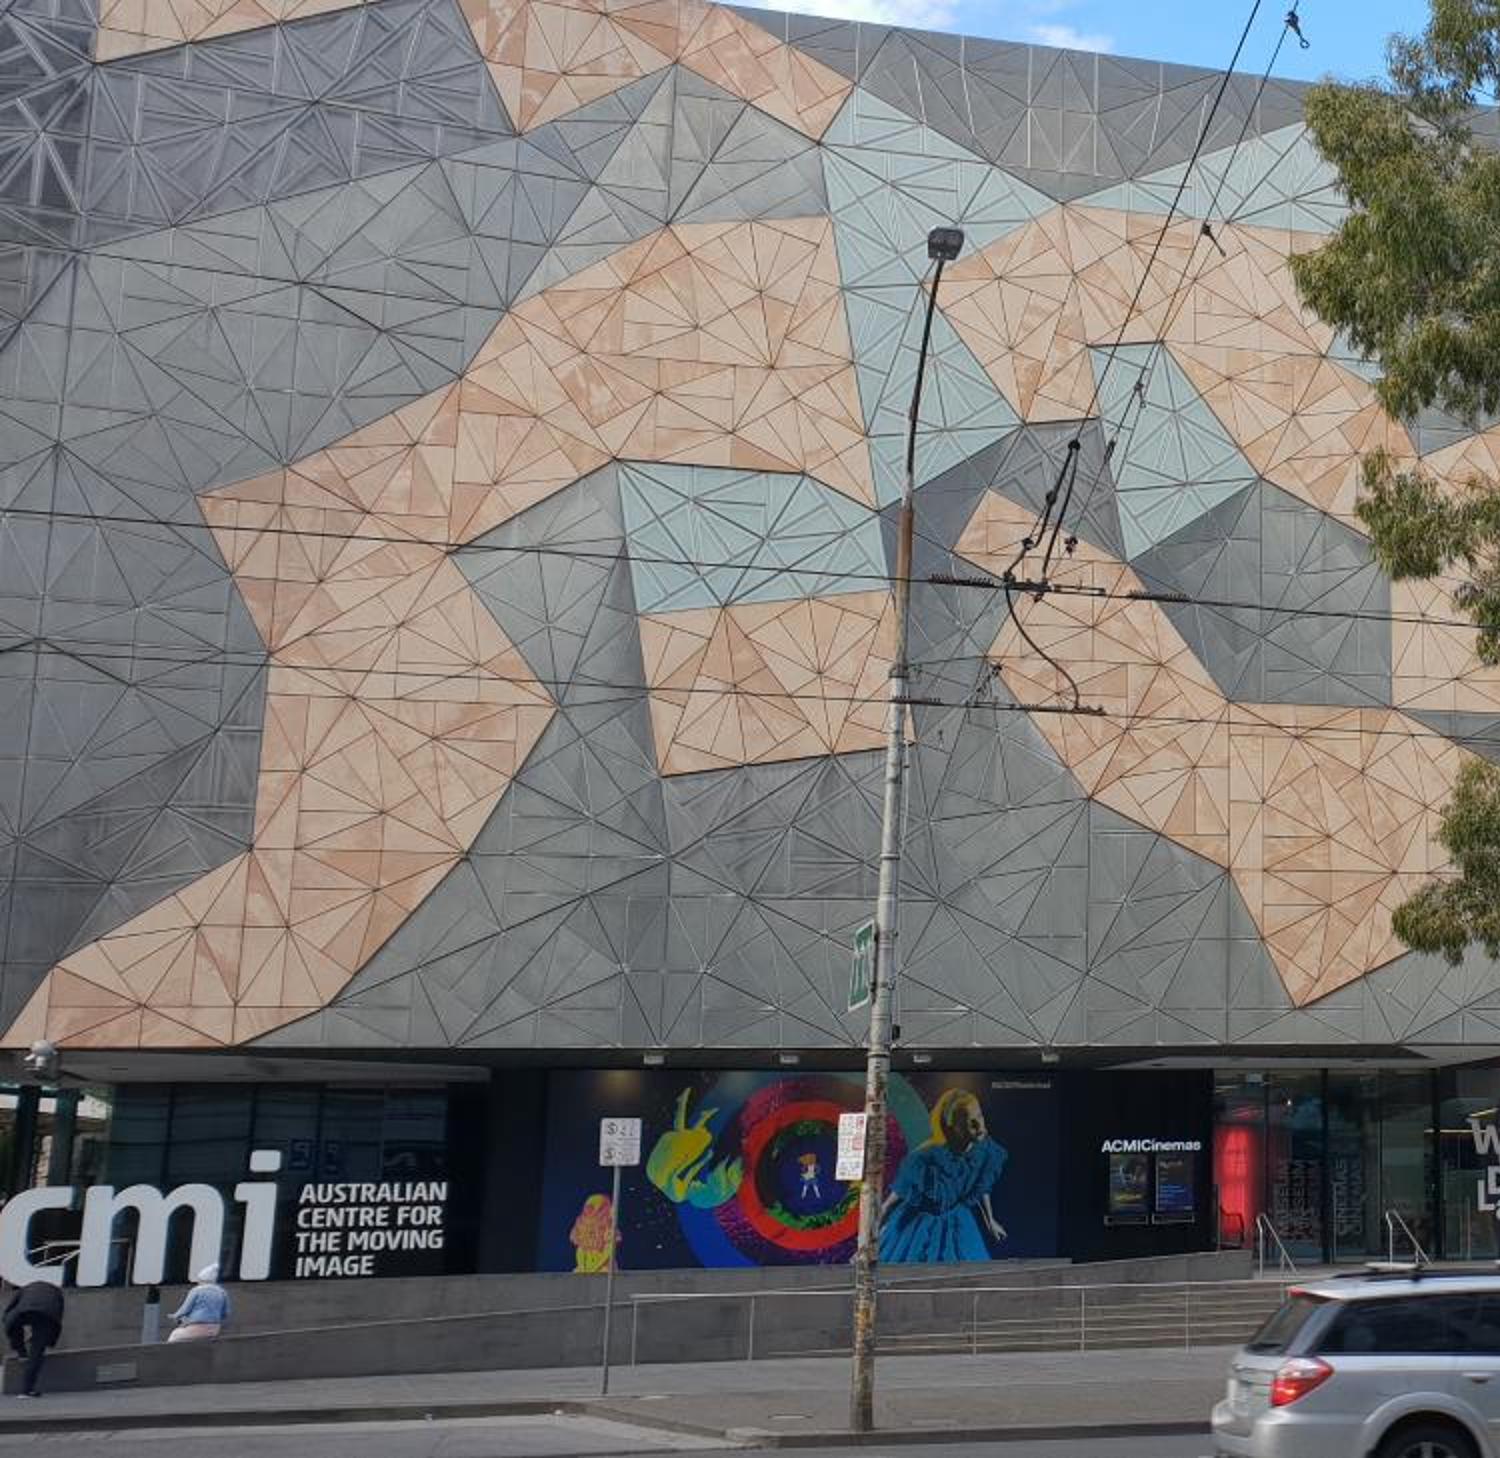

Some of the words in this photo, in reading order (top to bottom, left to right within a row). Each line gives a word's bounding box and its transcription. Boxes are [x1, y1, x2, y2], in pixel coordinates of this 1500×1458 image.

[300, 1181, 448, 1203] AUSTRALIAN
[0, 1149, 281, 1287] cmi
[297, 1206, 390, 1228] CENTRE
[397, 1205, 444, 1226] FOR
[296, 1231, 342, 1253] THE
[347, 1229, 444, 1251] MOVING
[295, 1255, 375, 1278] IMAGE
